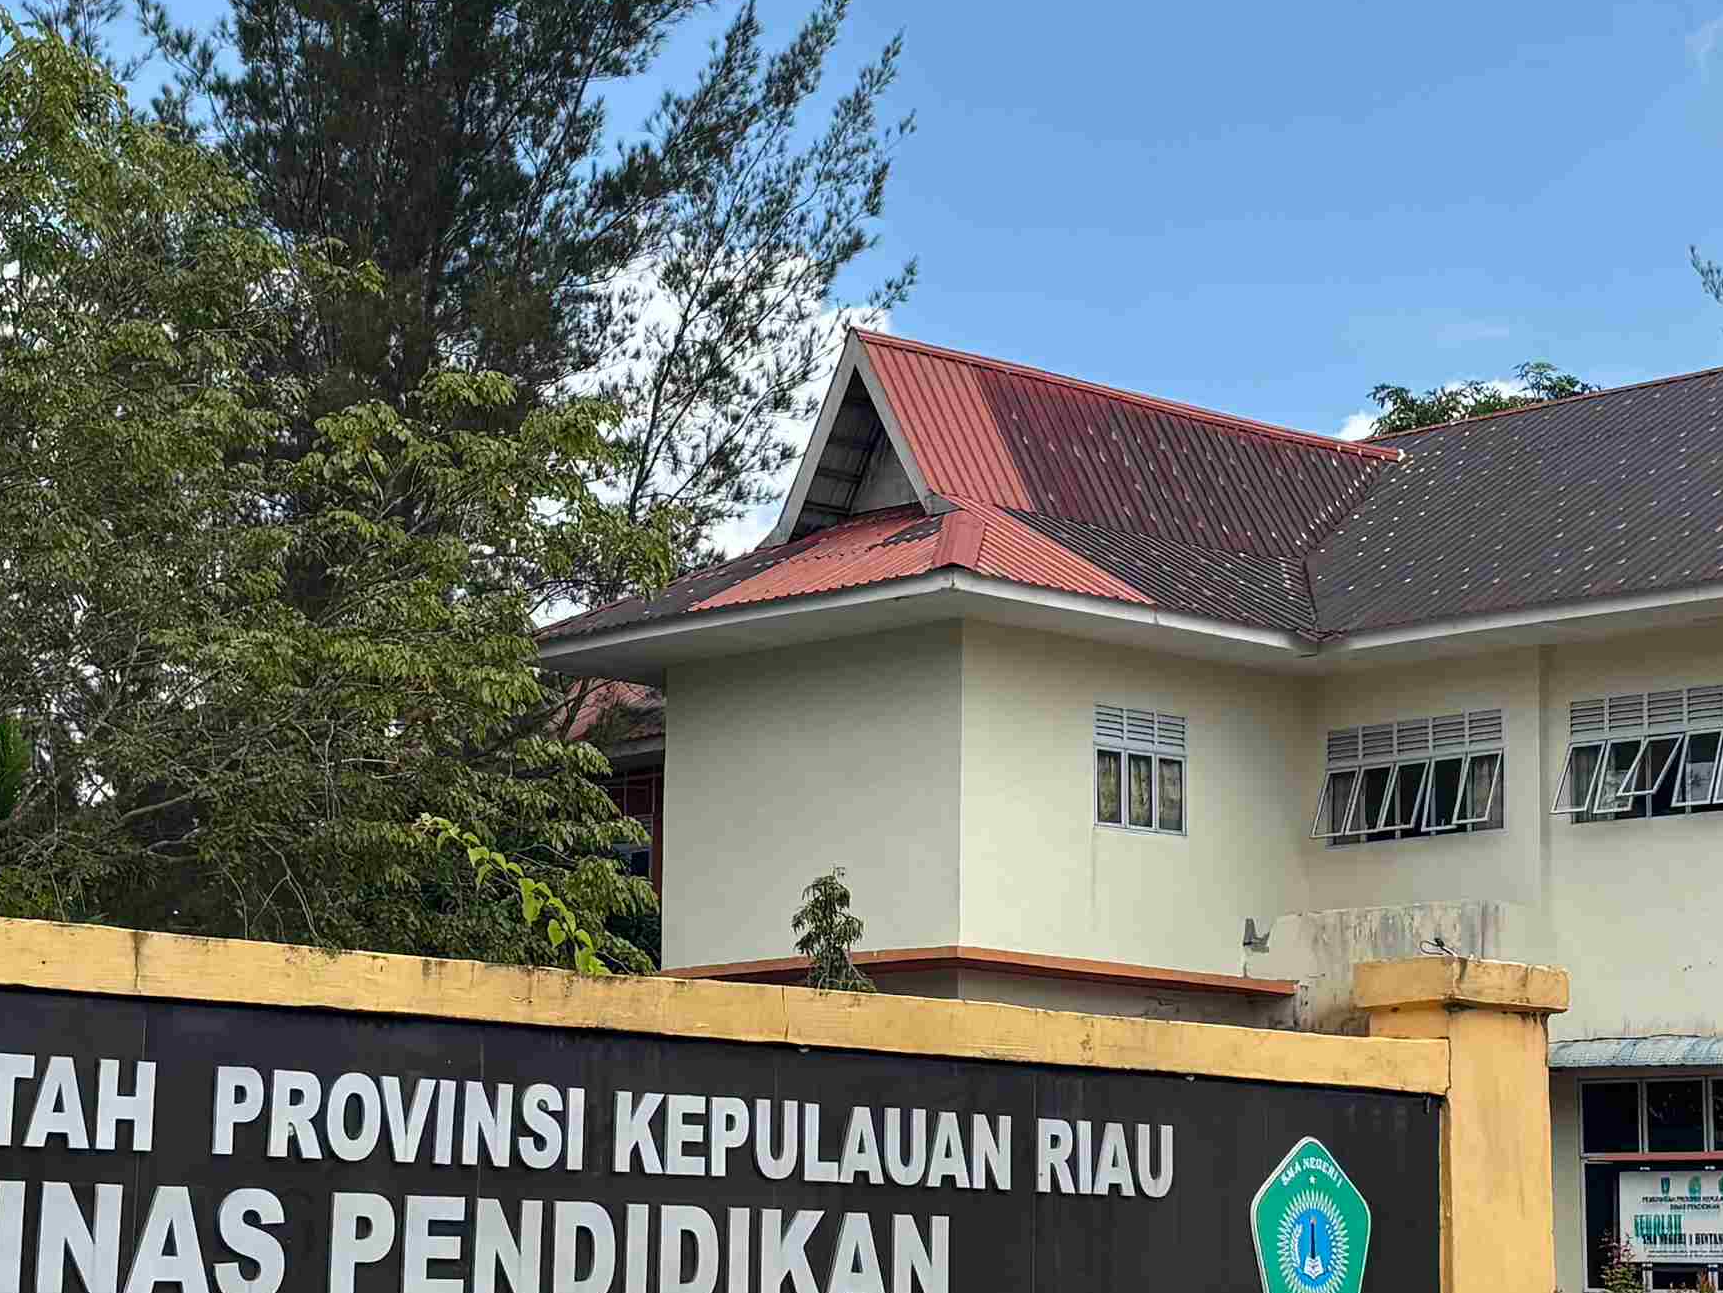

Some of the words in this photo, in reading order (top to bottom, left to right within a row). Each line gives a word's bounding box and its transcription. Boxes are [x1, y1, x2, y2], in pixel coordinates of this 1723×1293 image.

[213, 1066, 584, 1170] PROVINSI
[615, 1091, 1011, 1189] KEPULAUAN
[1038, 1119, 1173, 1197] RIAU
